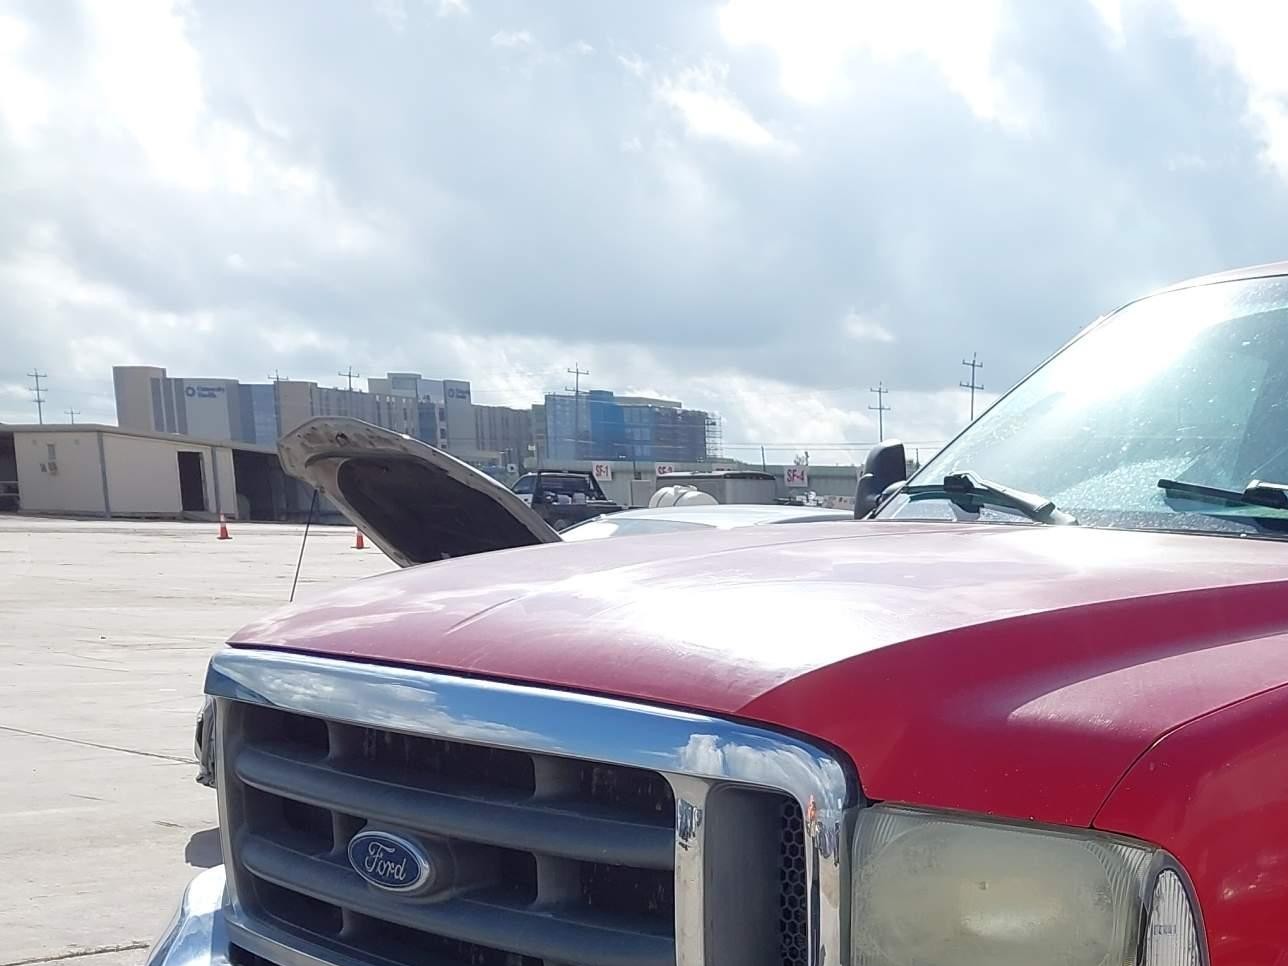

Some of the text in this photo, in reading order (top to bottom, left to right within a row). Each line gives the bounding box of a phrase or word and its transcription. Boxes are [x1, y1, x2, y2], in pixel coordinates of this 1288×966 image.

[595, 464, 609, 477] SF-1
[787, 469, 804, 482] SF-4
[364, 841, 407, 881] Ford
